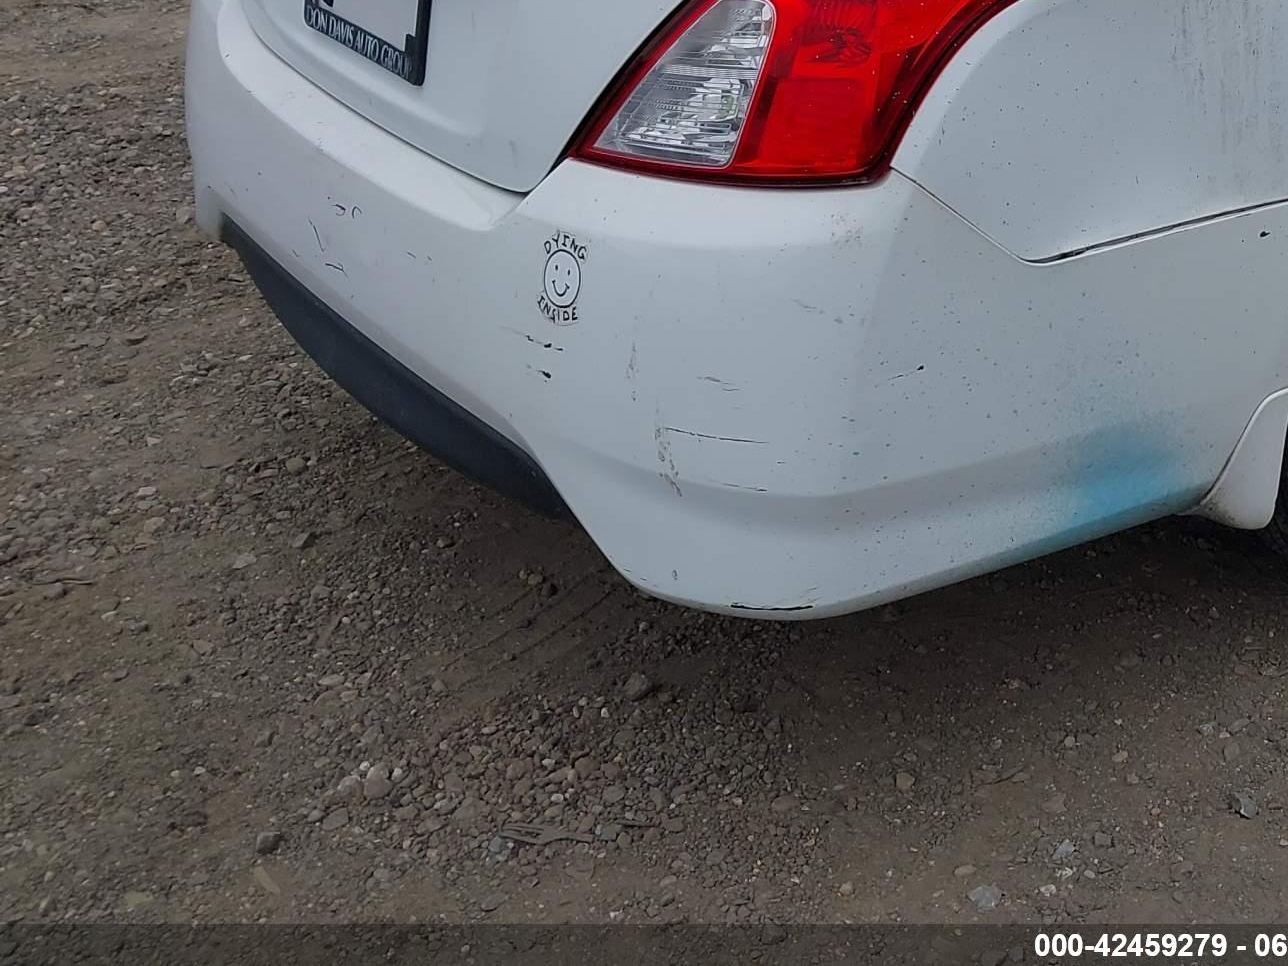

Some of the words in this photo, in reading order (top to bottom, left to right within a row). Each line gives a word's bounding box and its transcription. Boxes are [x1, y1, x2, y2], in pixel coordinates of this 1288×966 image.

[306, 5, 328, 32] DON
[328, 17, 355, 47] DAVIS
[354, 30, 380, 61] AUTO
[381, 45, 412, 79] GROUP
[544, 230, 588, 260] DYING
[537, 296, 578, 323] INSIDE
